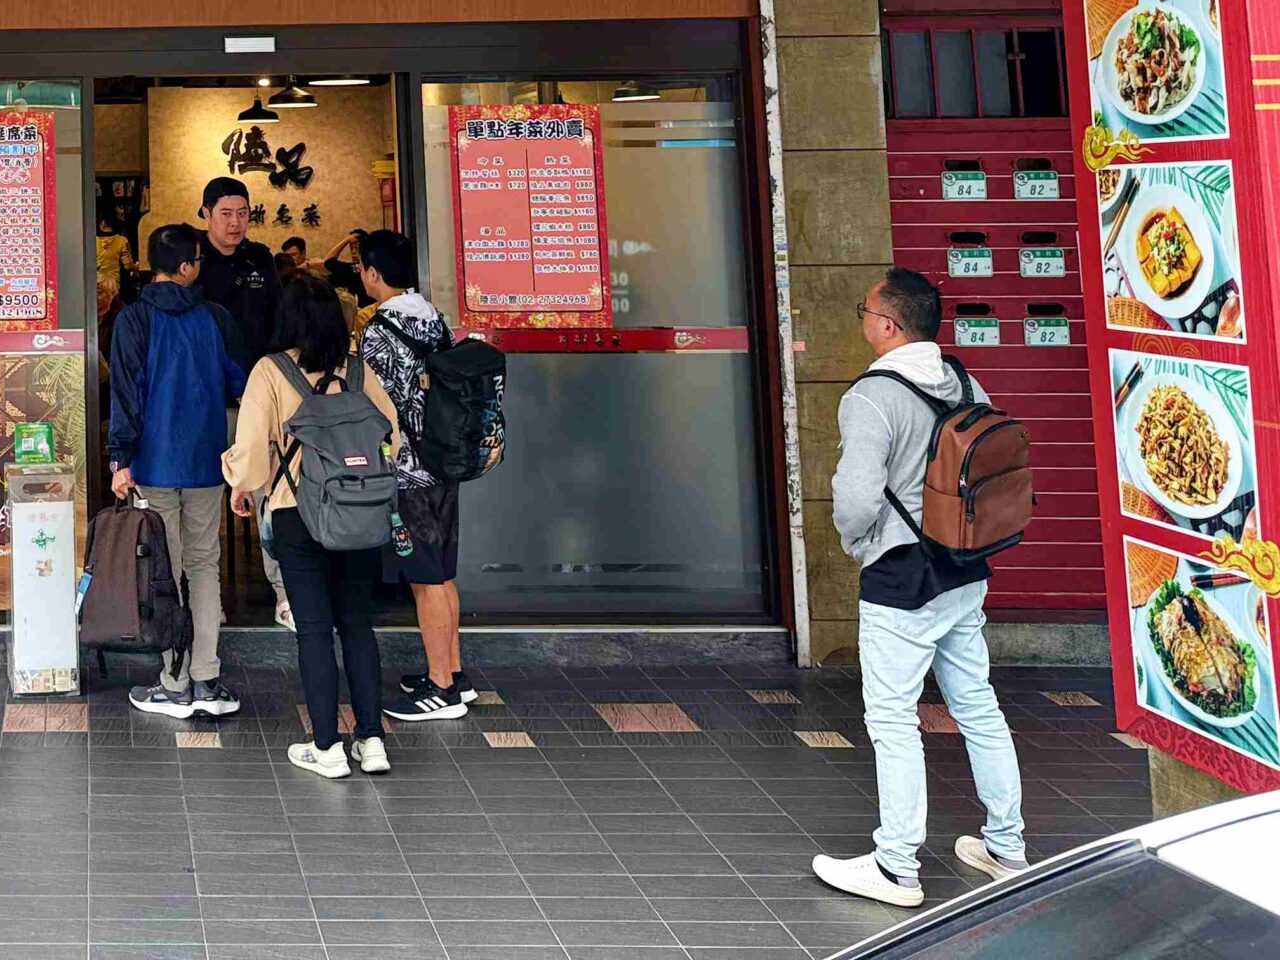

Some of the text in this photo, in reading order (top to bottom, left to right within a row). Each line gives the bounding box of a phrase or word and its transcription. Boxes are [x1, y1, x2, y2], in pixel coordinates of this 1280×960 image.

[467, 119, 585, 139] 單點年菜外賣
[957, 184, 972, 196] 84
[1029, 184, 1045, 196] 82
[963, 262, 978, 274] 84
[1035, 262, 1051, 274] 82
[970, 331, 986, 343] 84
[1040, 331, 1056, 343] 82
